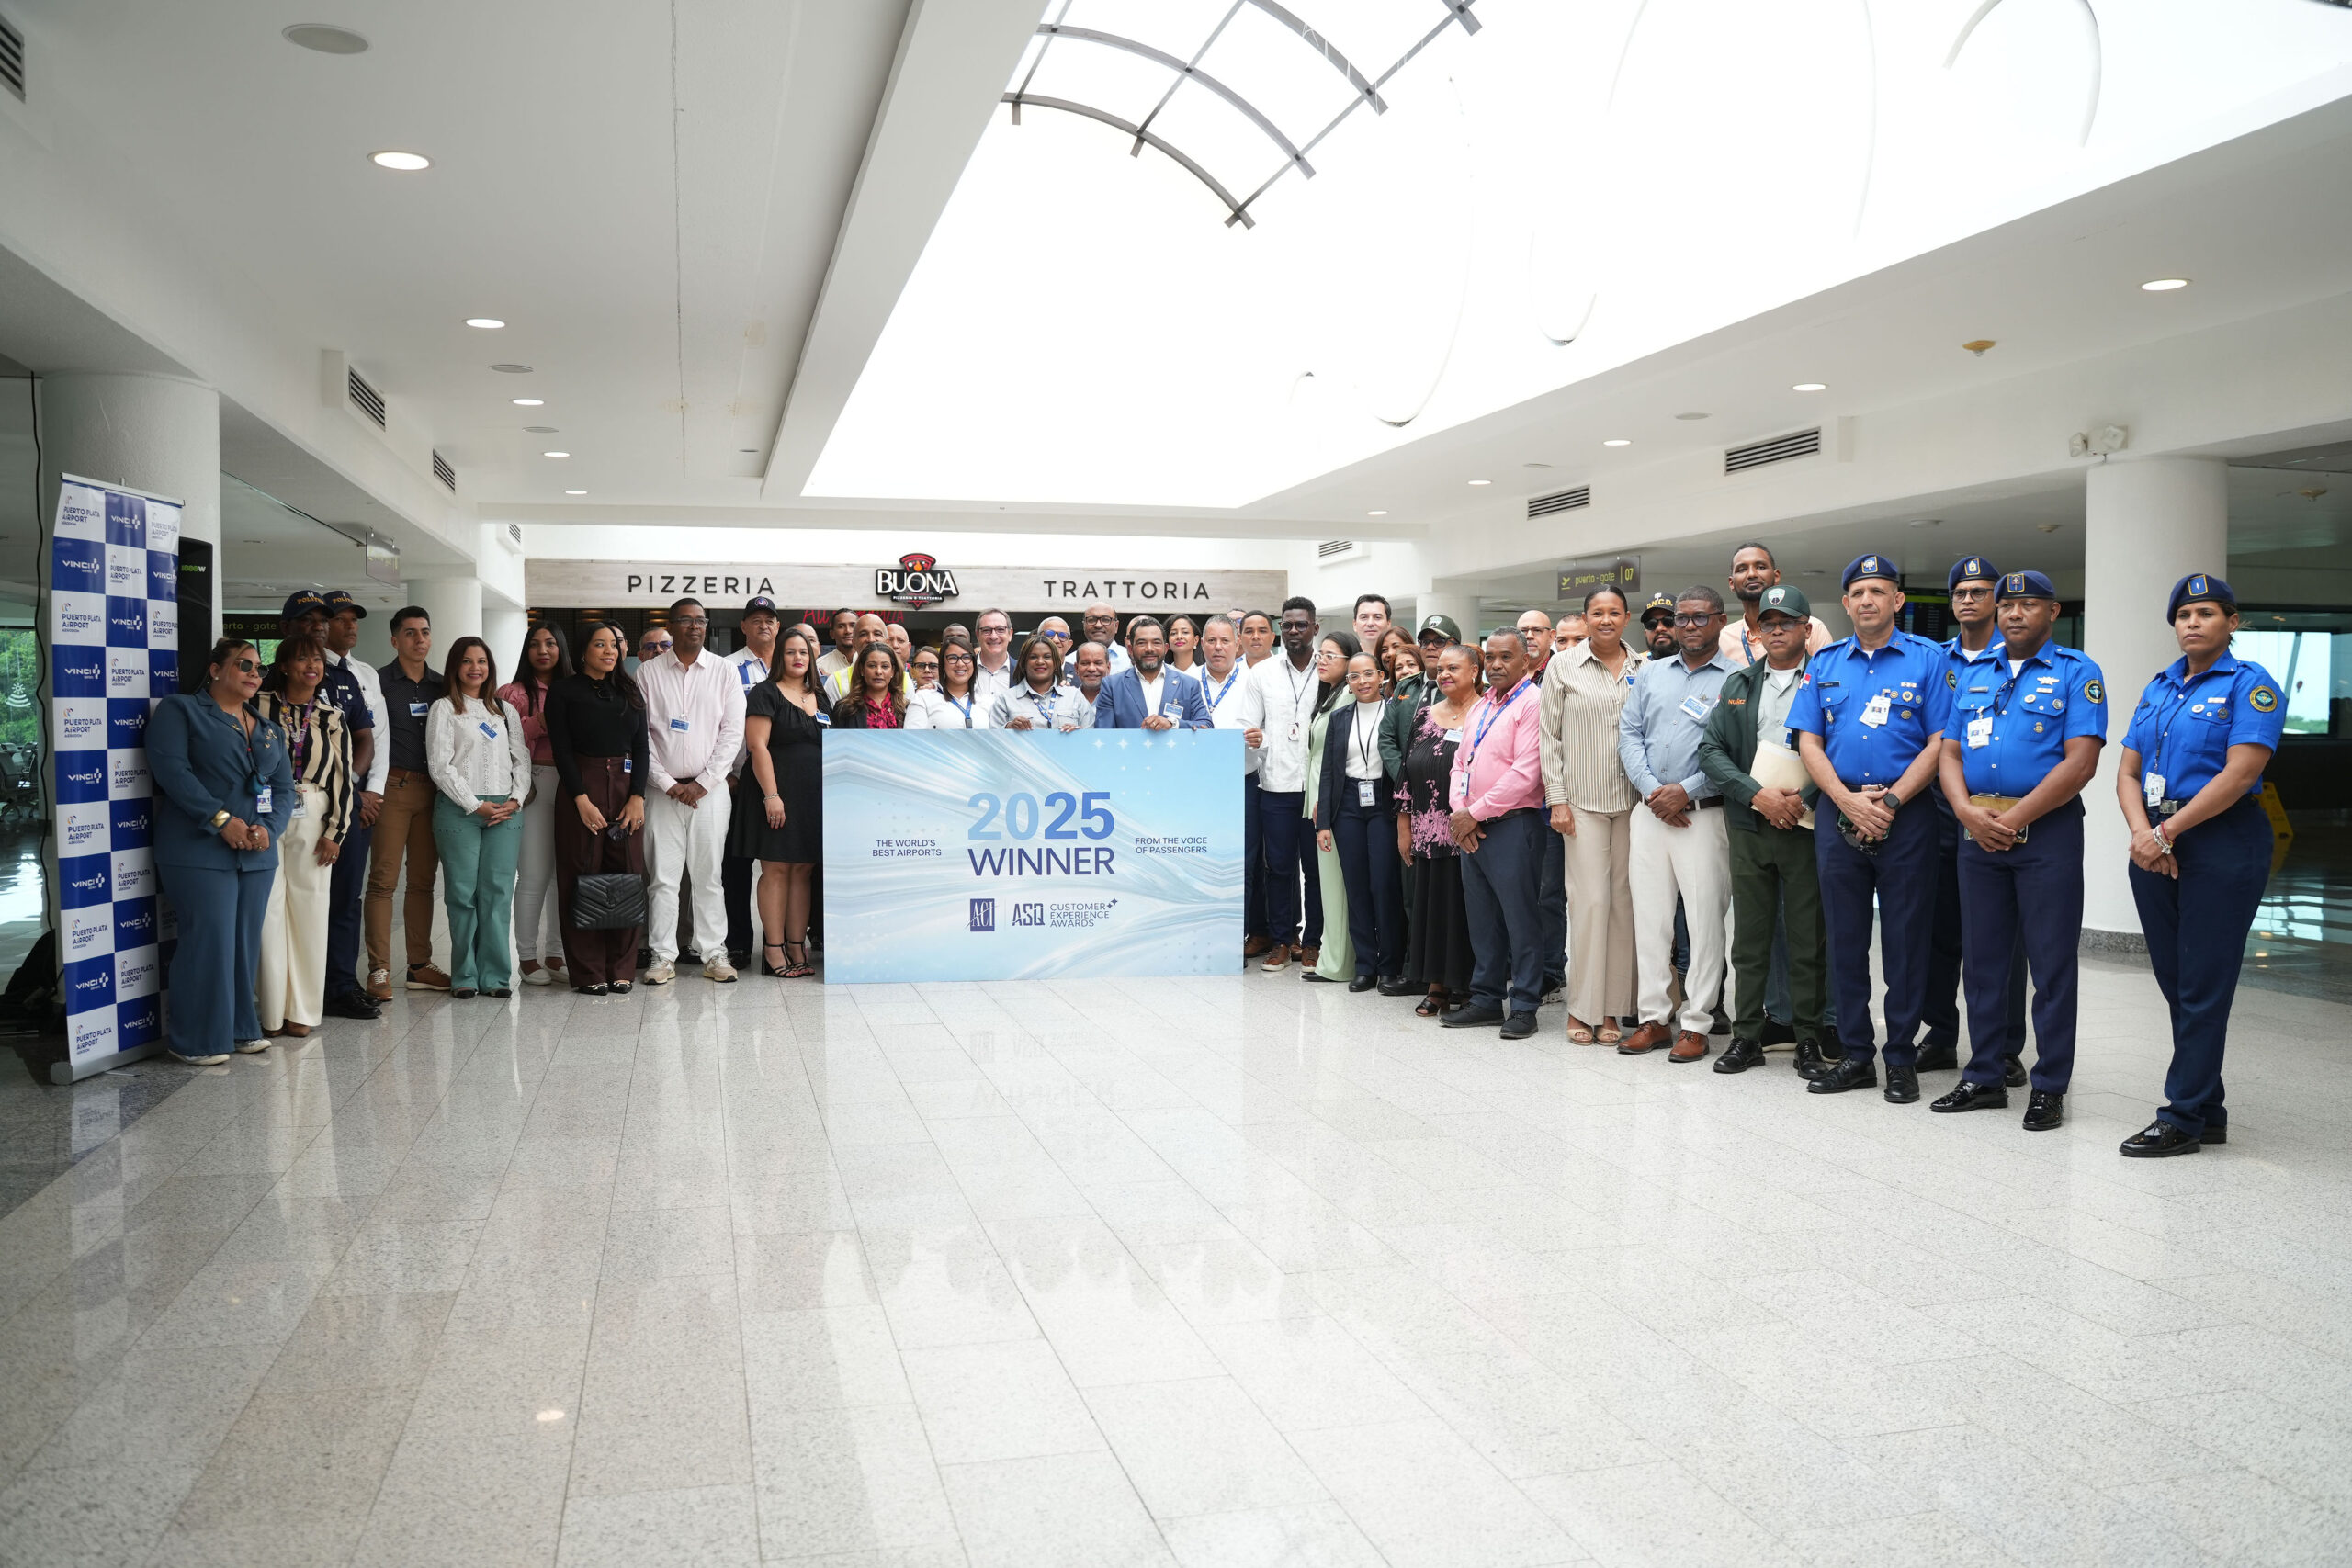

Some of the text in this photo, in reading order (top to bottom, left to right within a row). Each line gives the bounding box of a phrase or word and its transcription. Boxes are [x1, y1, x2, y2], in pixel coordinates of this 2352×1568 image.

[111, 515, 131, 524] VINCI
[62, 560, 90, 569] VINCI
[1575, 574, 1595, 586] puerta
[1600, 572, 1615, 585] gate
[1625, 567, 1634, 581] 07
[628, 575, 775, 595] PIZZERIA
[877, 570, 957, 594] BUONA
[1043, 580, 1210, 600] TRATTORIA
[253, 622, 276, 631] gate
[967, 792, 1114, 840] 2025
[967, 847, 1115, 876] WINNER
[72, 879, 95, 888] VINCI
[1050, 903, 1106, 911] CUSTOMER
[971, 901, 994, 926] ACI
[1012, 903, 1045, 926] ASQ
[1050, 911, 1109, 919] EXPERIENCE
[121, 919, 142, 928] VINCI
[1050, 919, 1094, 927] AWARDS
[72, 928, 92, 937] PUERTO
[121, 968, 140, 977] PUERTO
[76, 979, 98, 989] VINCI
[124, 1019, 145, 1029] VINCI
[77, 1027, 112, 1042] PUERTO PLATA
